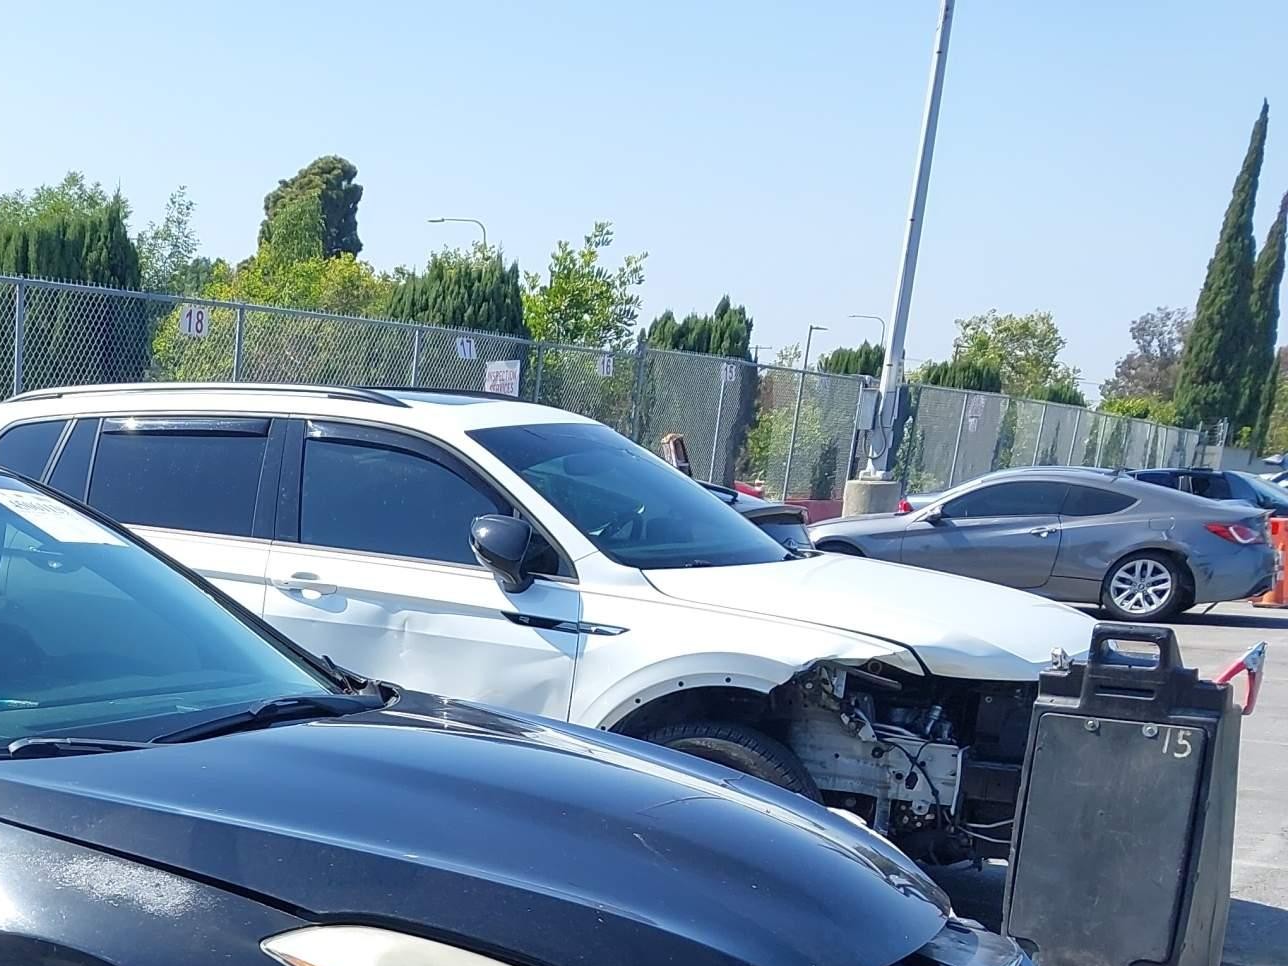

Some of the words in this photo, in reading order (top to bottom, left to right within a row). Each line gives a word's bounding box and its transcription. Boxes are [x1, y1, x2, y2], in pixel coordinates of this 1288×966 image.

[185, 309, 204, 334] 18
[460, 339, 472, 358] 17
[602, 357, 611, 375] 16
[1162, 727, 1192, 758] 15
